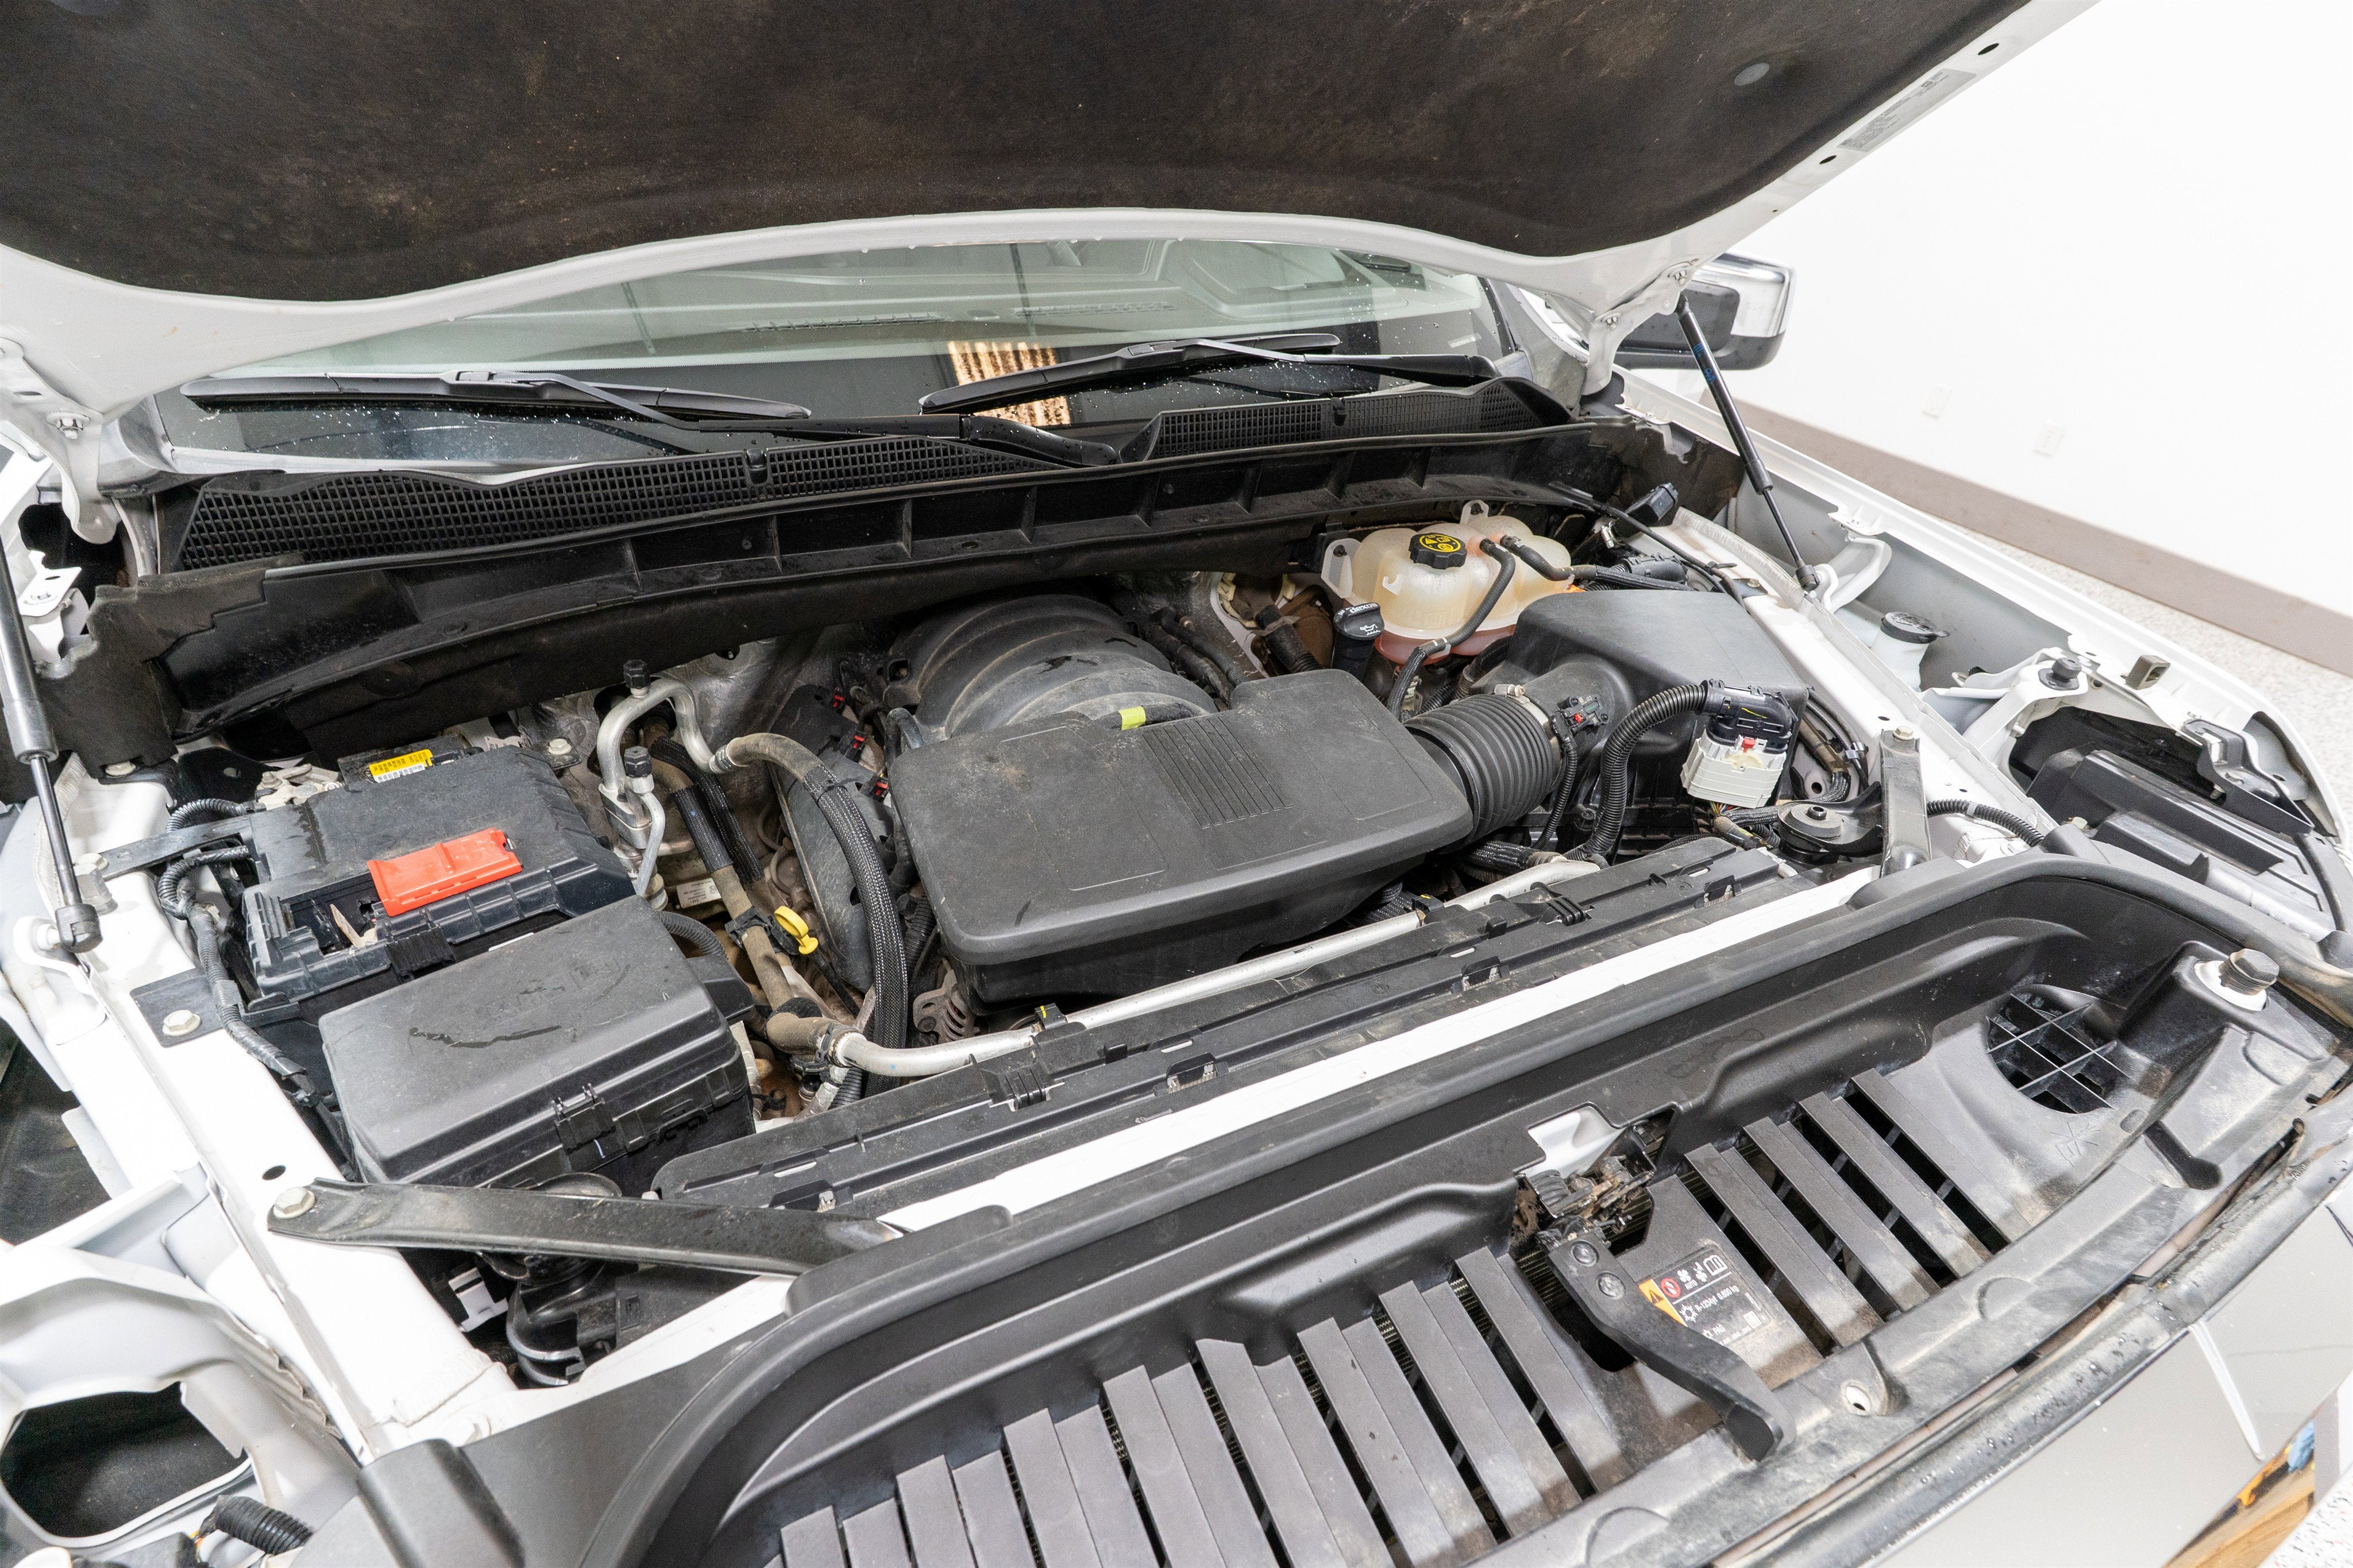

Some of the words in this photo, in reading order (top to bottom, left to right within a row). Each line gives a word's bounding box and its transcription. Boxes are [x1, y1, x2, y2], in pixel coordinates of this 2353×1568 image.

[1349, 603, 1378, 613] dexos
[1684, 1279, 1698, 1291] AUTO
[1694, 1295, 1718, 1312] R-1234yf
[1729, 1285, 1739, 1293] kg
[1712, 1324, 1726, 1335] PAG
